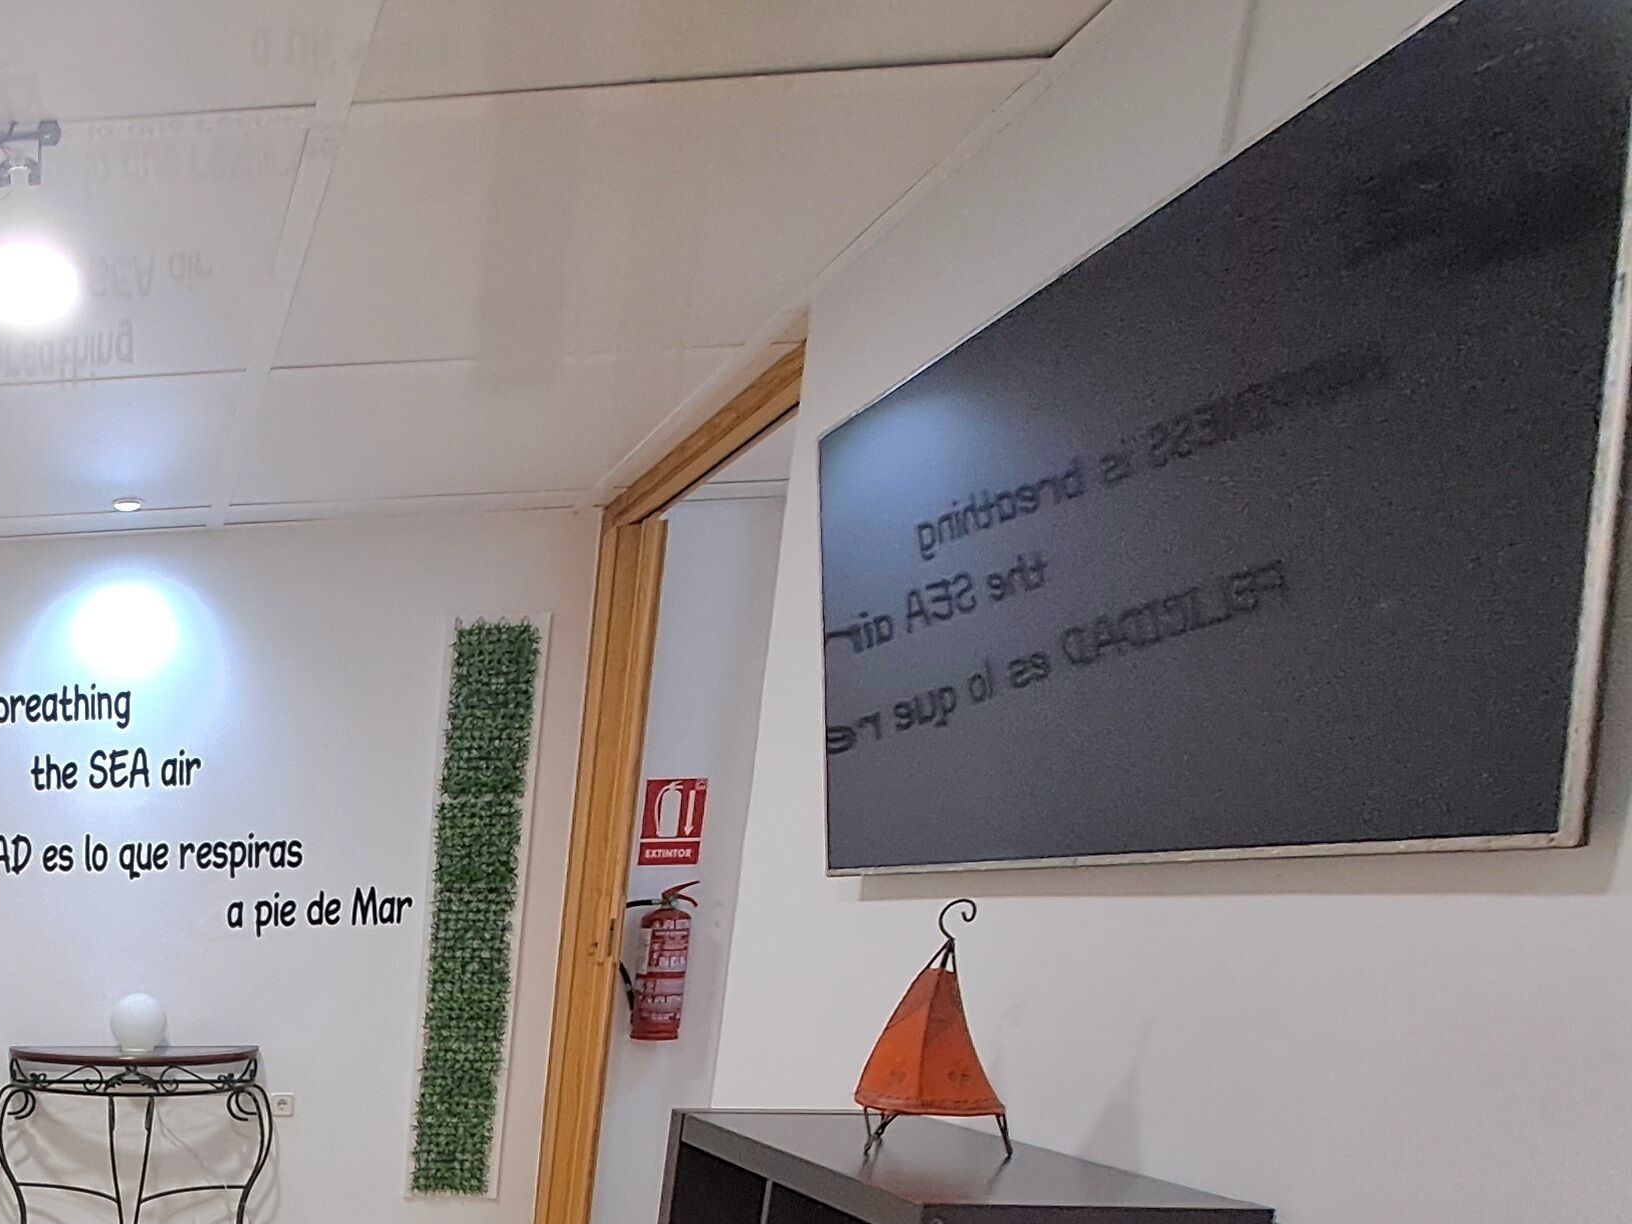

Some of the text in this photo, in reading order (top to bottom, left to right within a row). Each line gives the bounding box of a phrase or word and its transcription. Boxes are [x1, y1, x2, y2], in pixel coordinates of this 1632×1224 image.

[30, 748, 202, 791] the SEA air
[42, 844, 74, 872] es
[85, 834, 108, 872] lo
[119, 843, 169, 880] que
[179, 832, 303, 879] respiras
[644, 848, 692, 859] EXTINTOR
[227, 886, 413, 938] a pie de Mar
